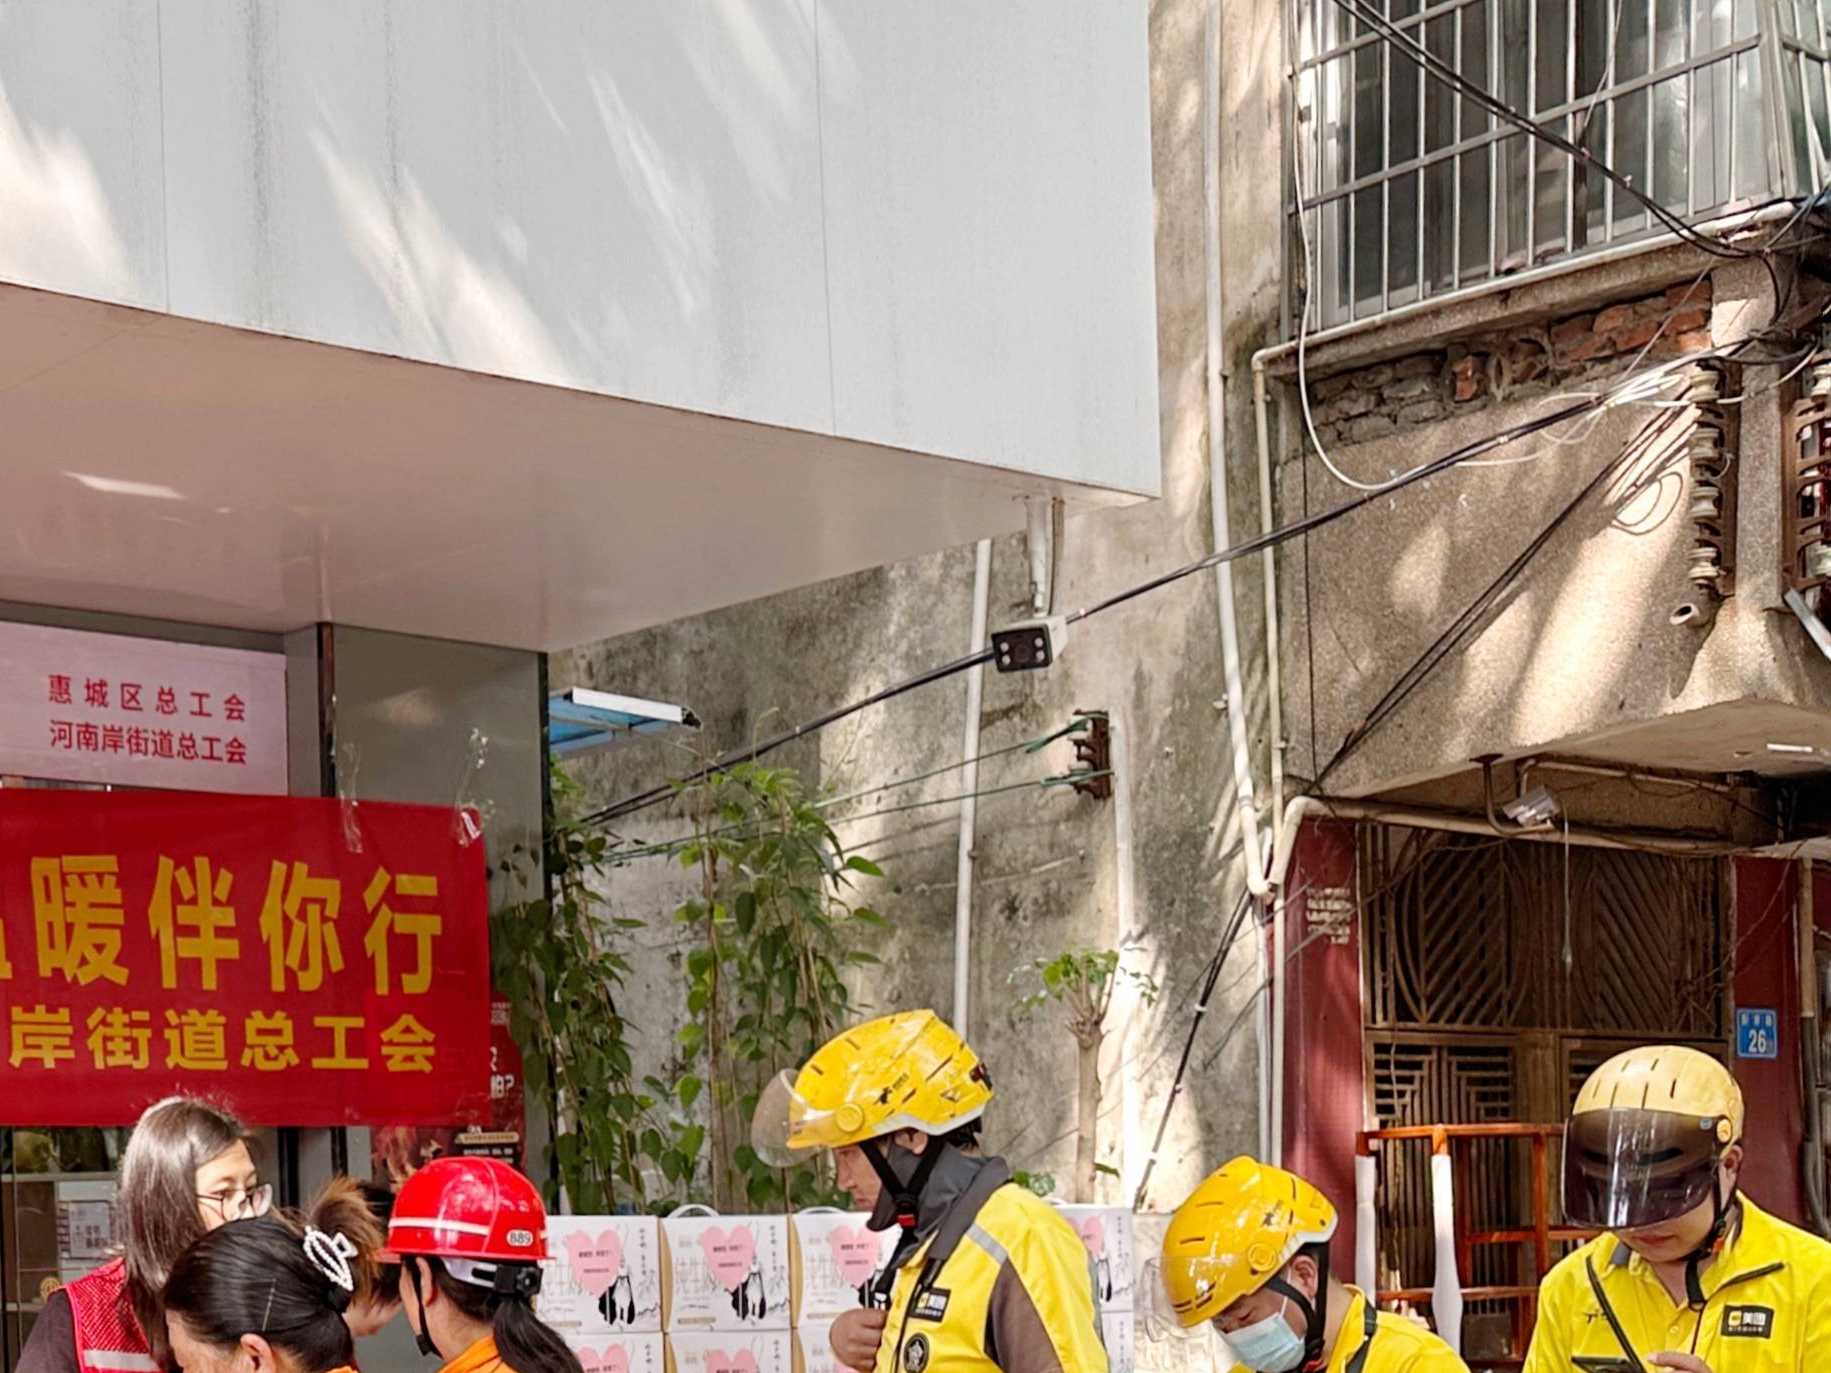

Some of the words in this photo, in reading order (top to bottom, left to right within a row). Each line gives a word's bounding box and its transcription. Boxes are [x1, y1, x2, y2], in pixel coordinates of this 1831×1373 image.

[47, 673, 248, 724] 惠城区总工会
[48, 719, 249, 767] 河南岸街道总工会
[1748, 1028, 1767, 1054] 26
[507, 1230, 532, 1245] 889
